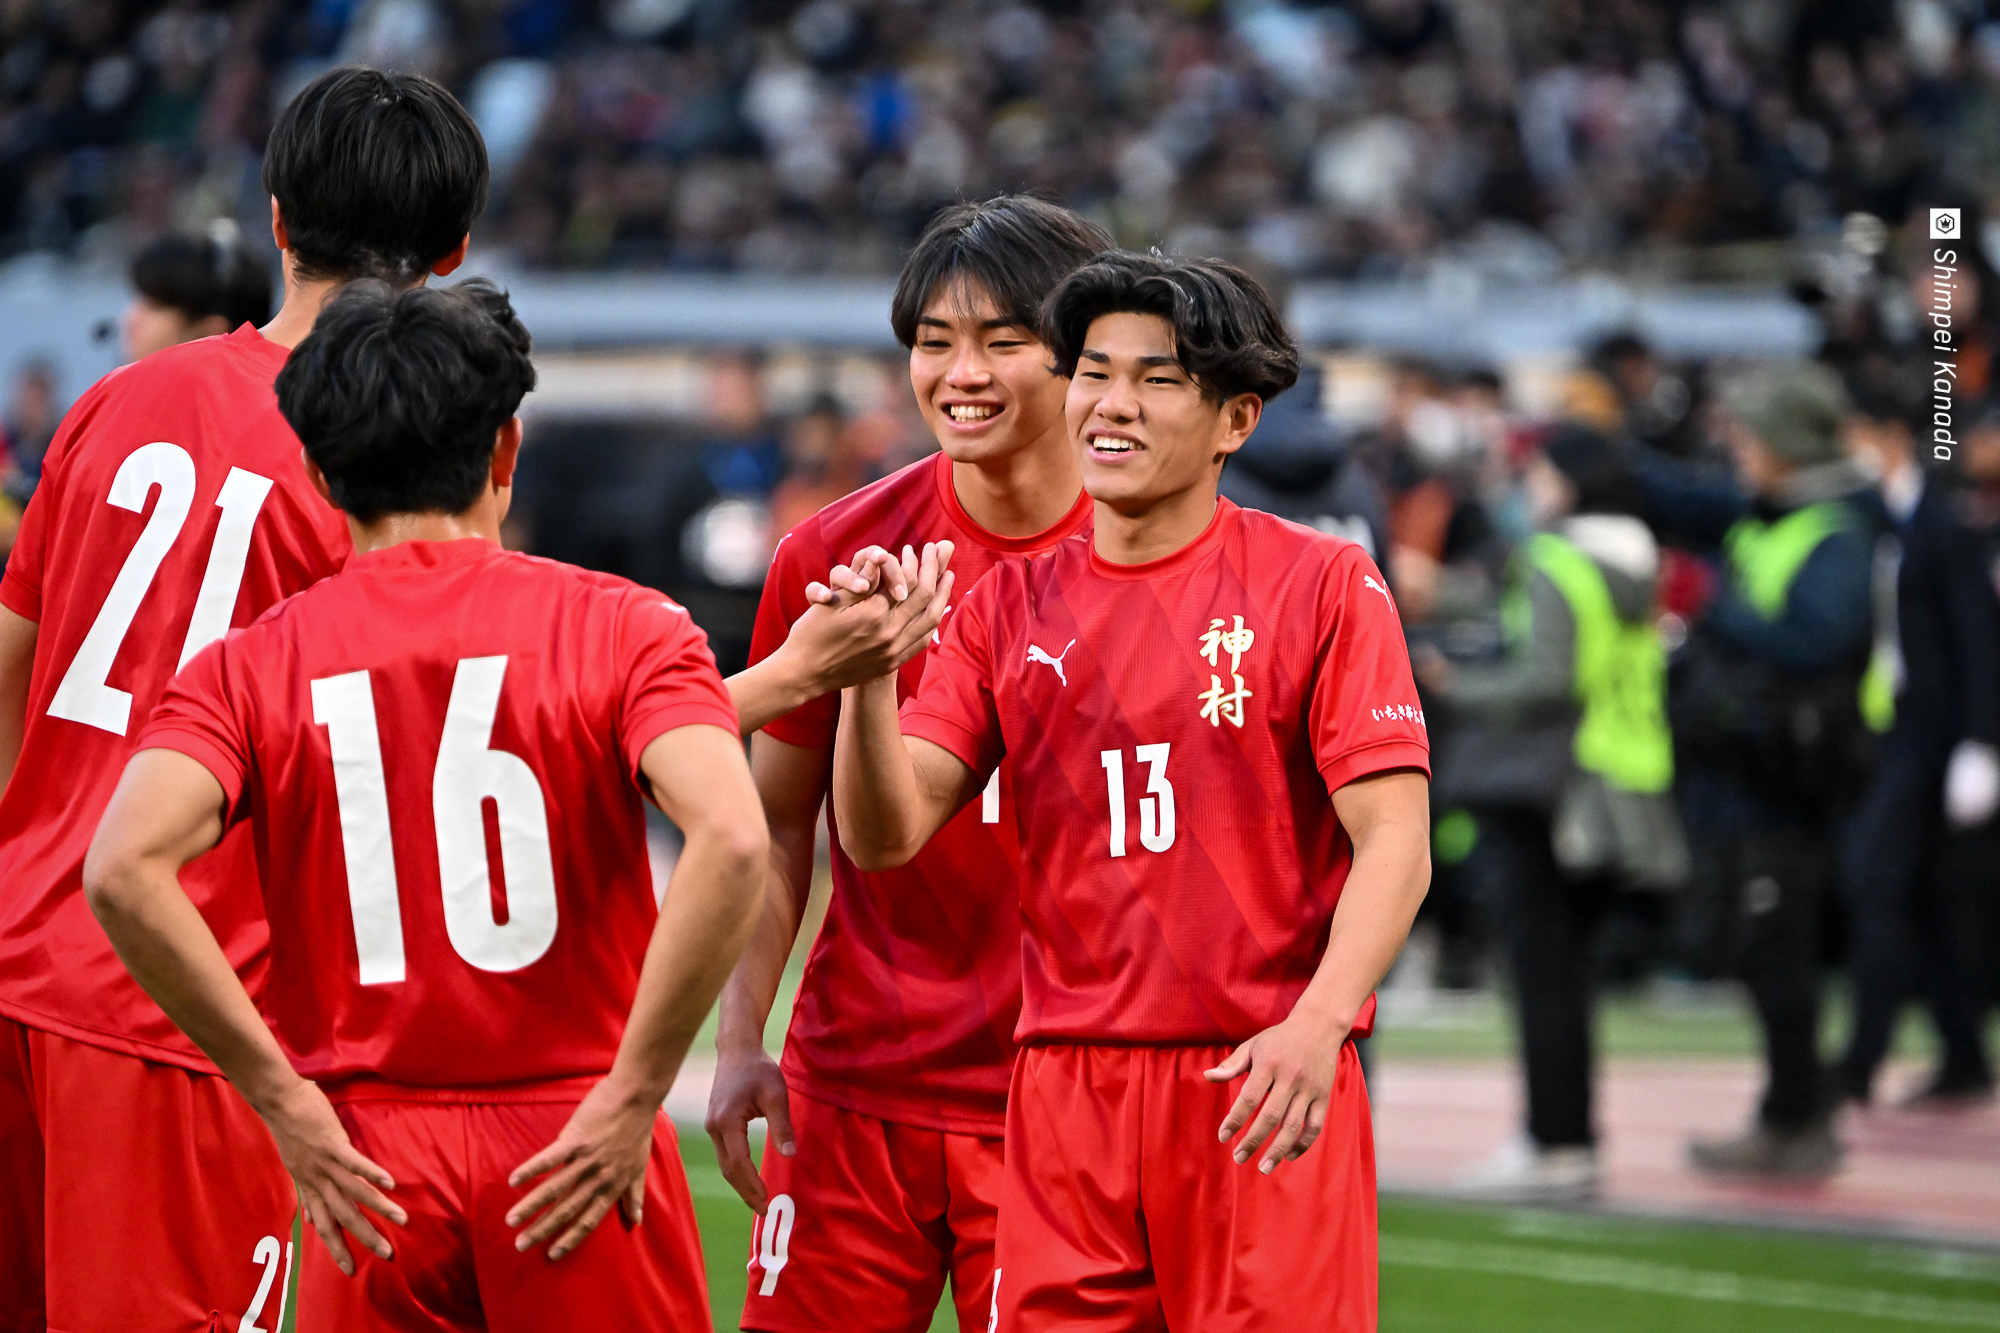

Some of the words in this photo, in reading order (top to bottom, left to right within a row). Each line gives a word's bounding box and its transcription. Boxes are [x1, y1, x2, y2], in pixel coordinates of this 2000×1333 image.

[46, 441, 274, 737] 21
[1197, 614, 1255, 728] 神村
[310, 655, 558, 985] 16
[1101, 742, 1176, 858] 13
